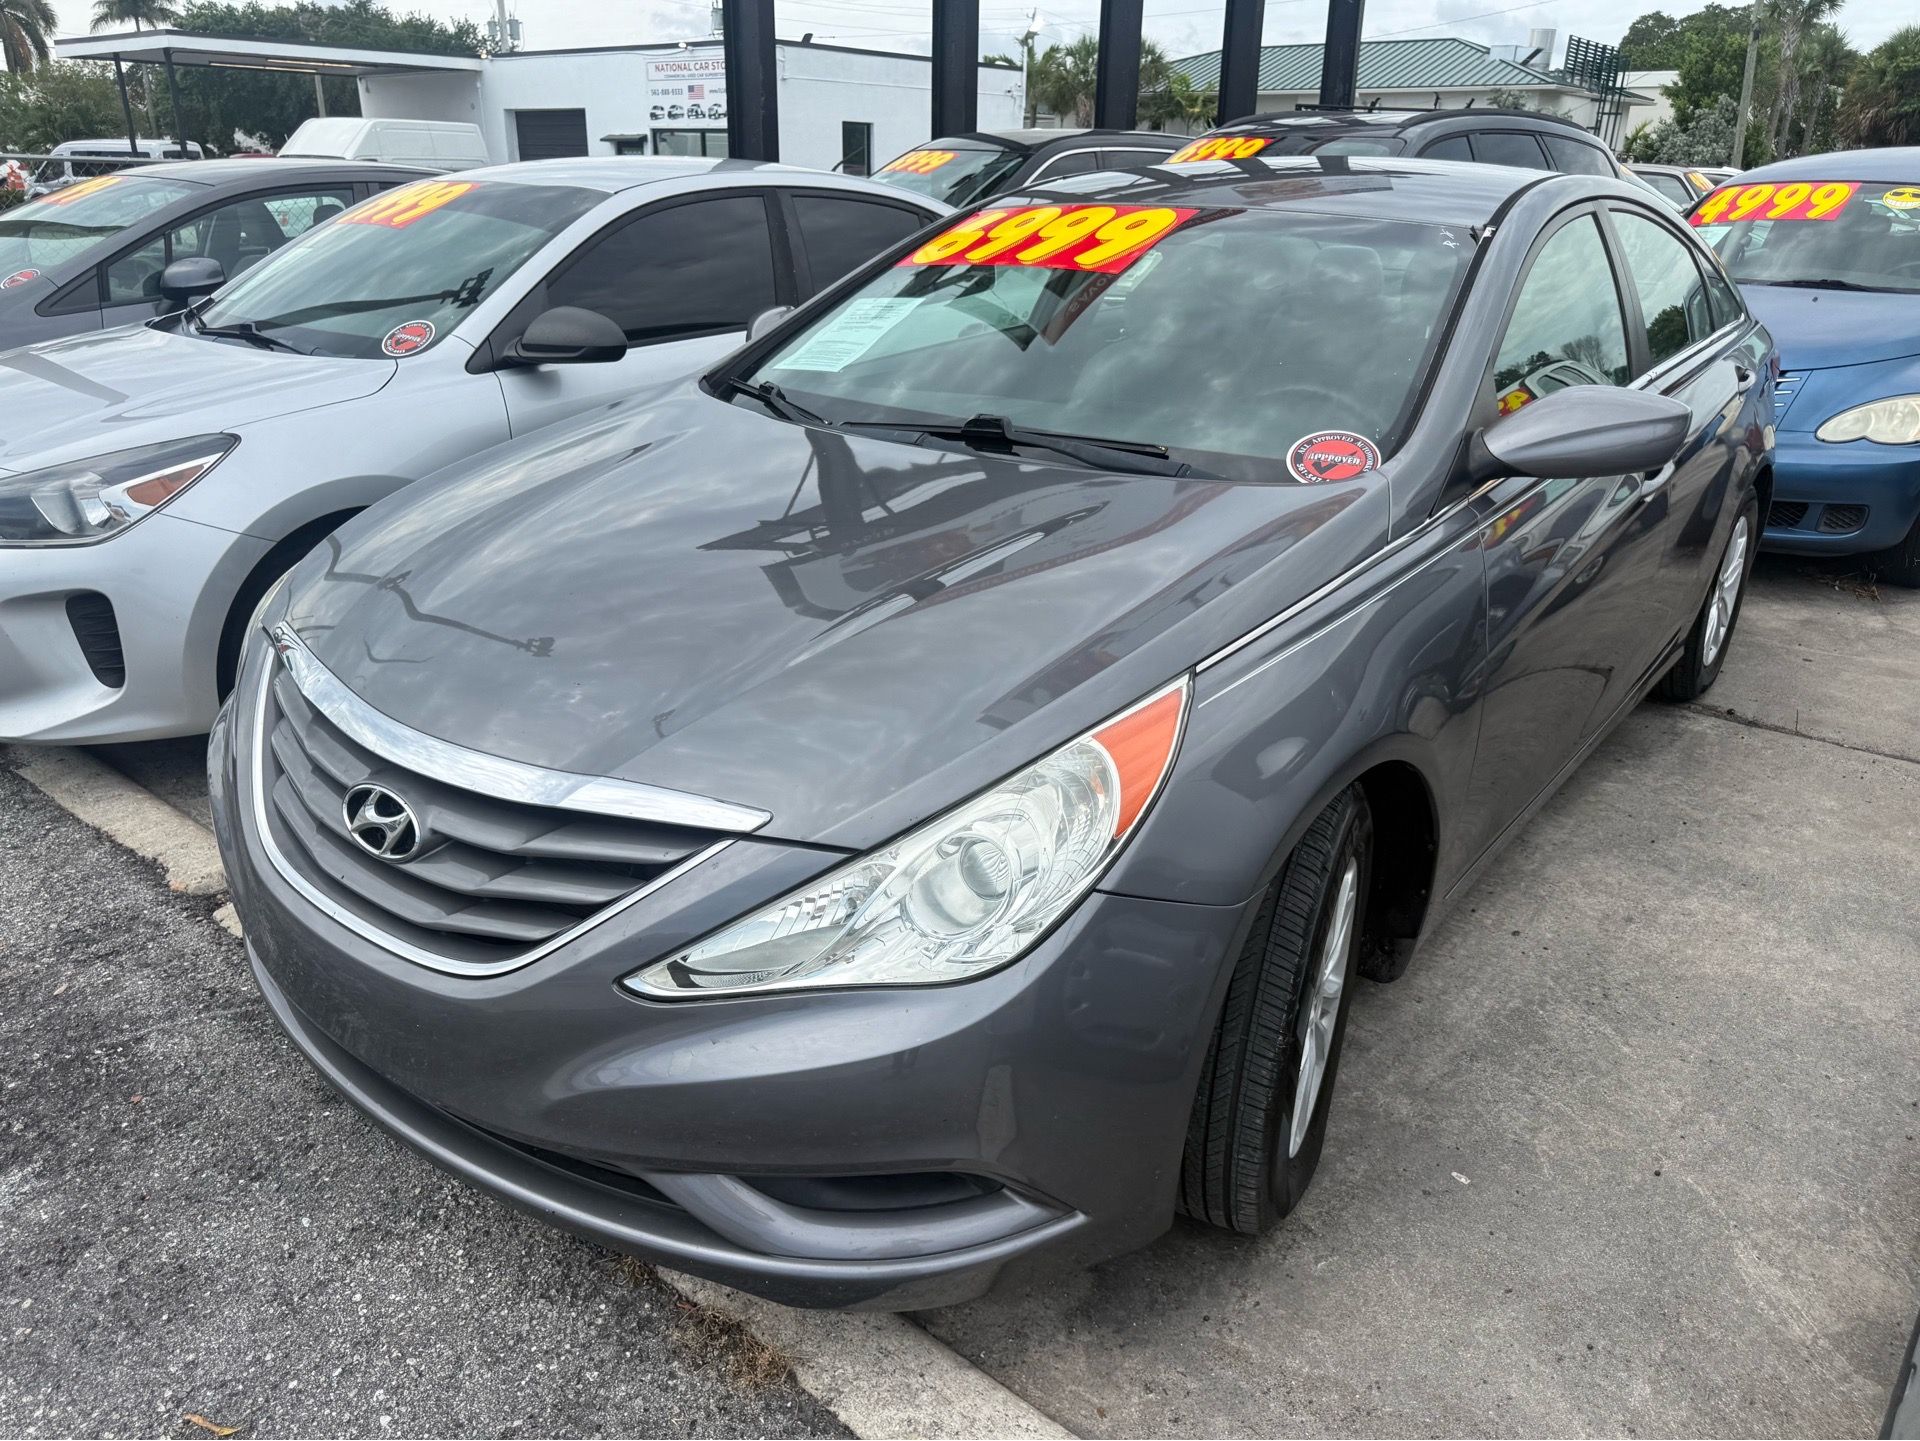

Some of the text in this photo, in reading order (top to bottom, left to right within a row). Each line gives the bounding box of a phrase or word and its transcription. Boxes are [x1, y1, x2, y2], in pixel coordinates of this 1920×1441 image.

[655, 63, 693, 72] NATIONAL
[694, 62, 710, 71] CAR
[1697, 182, 1854, 224] 4999
[910, 206, 1178, 269] 6999
[1298, 443, 1312, 454] ALL
[1312, 435, 1354, 445] APPROVED
